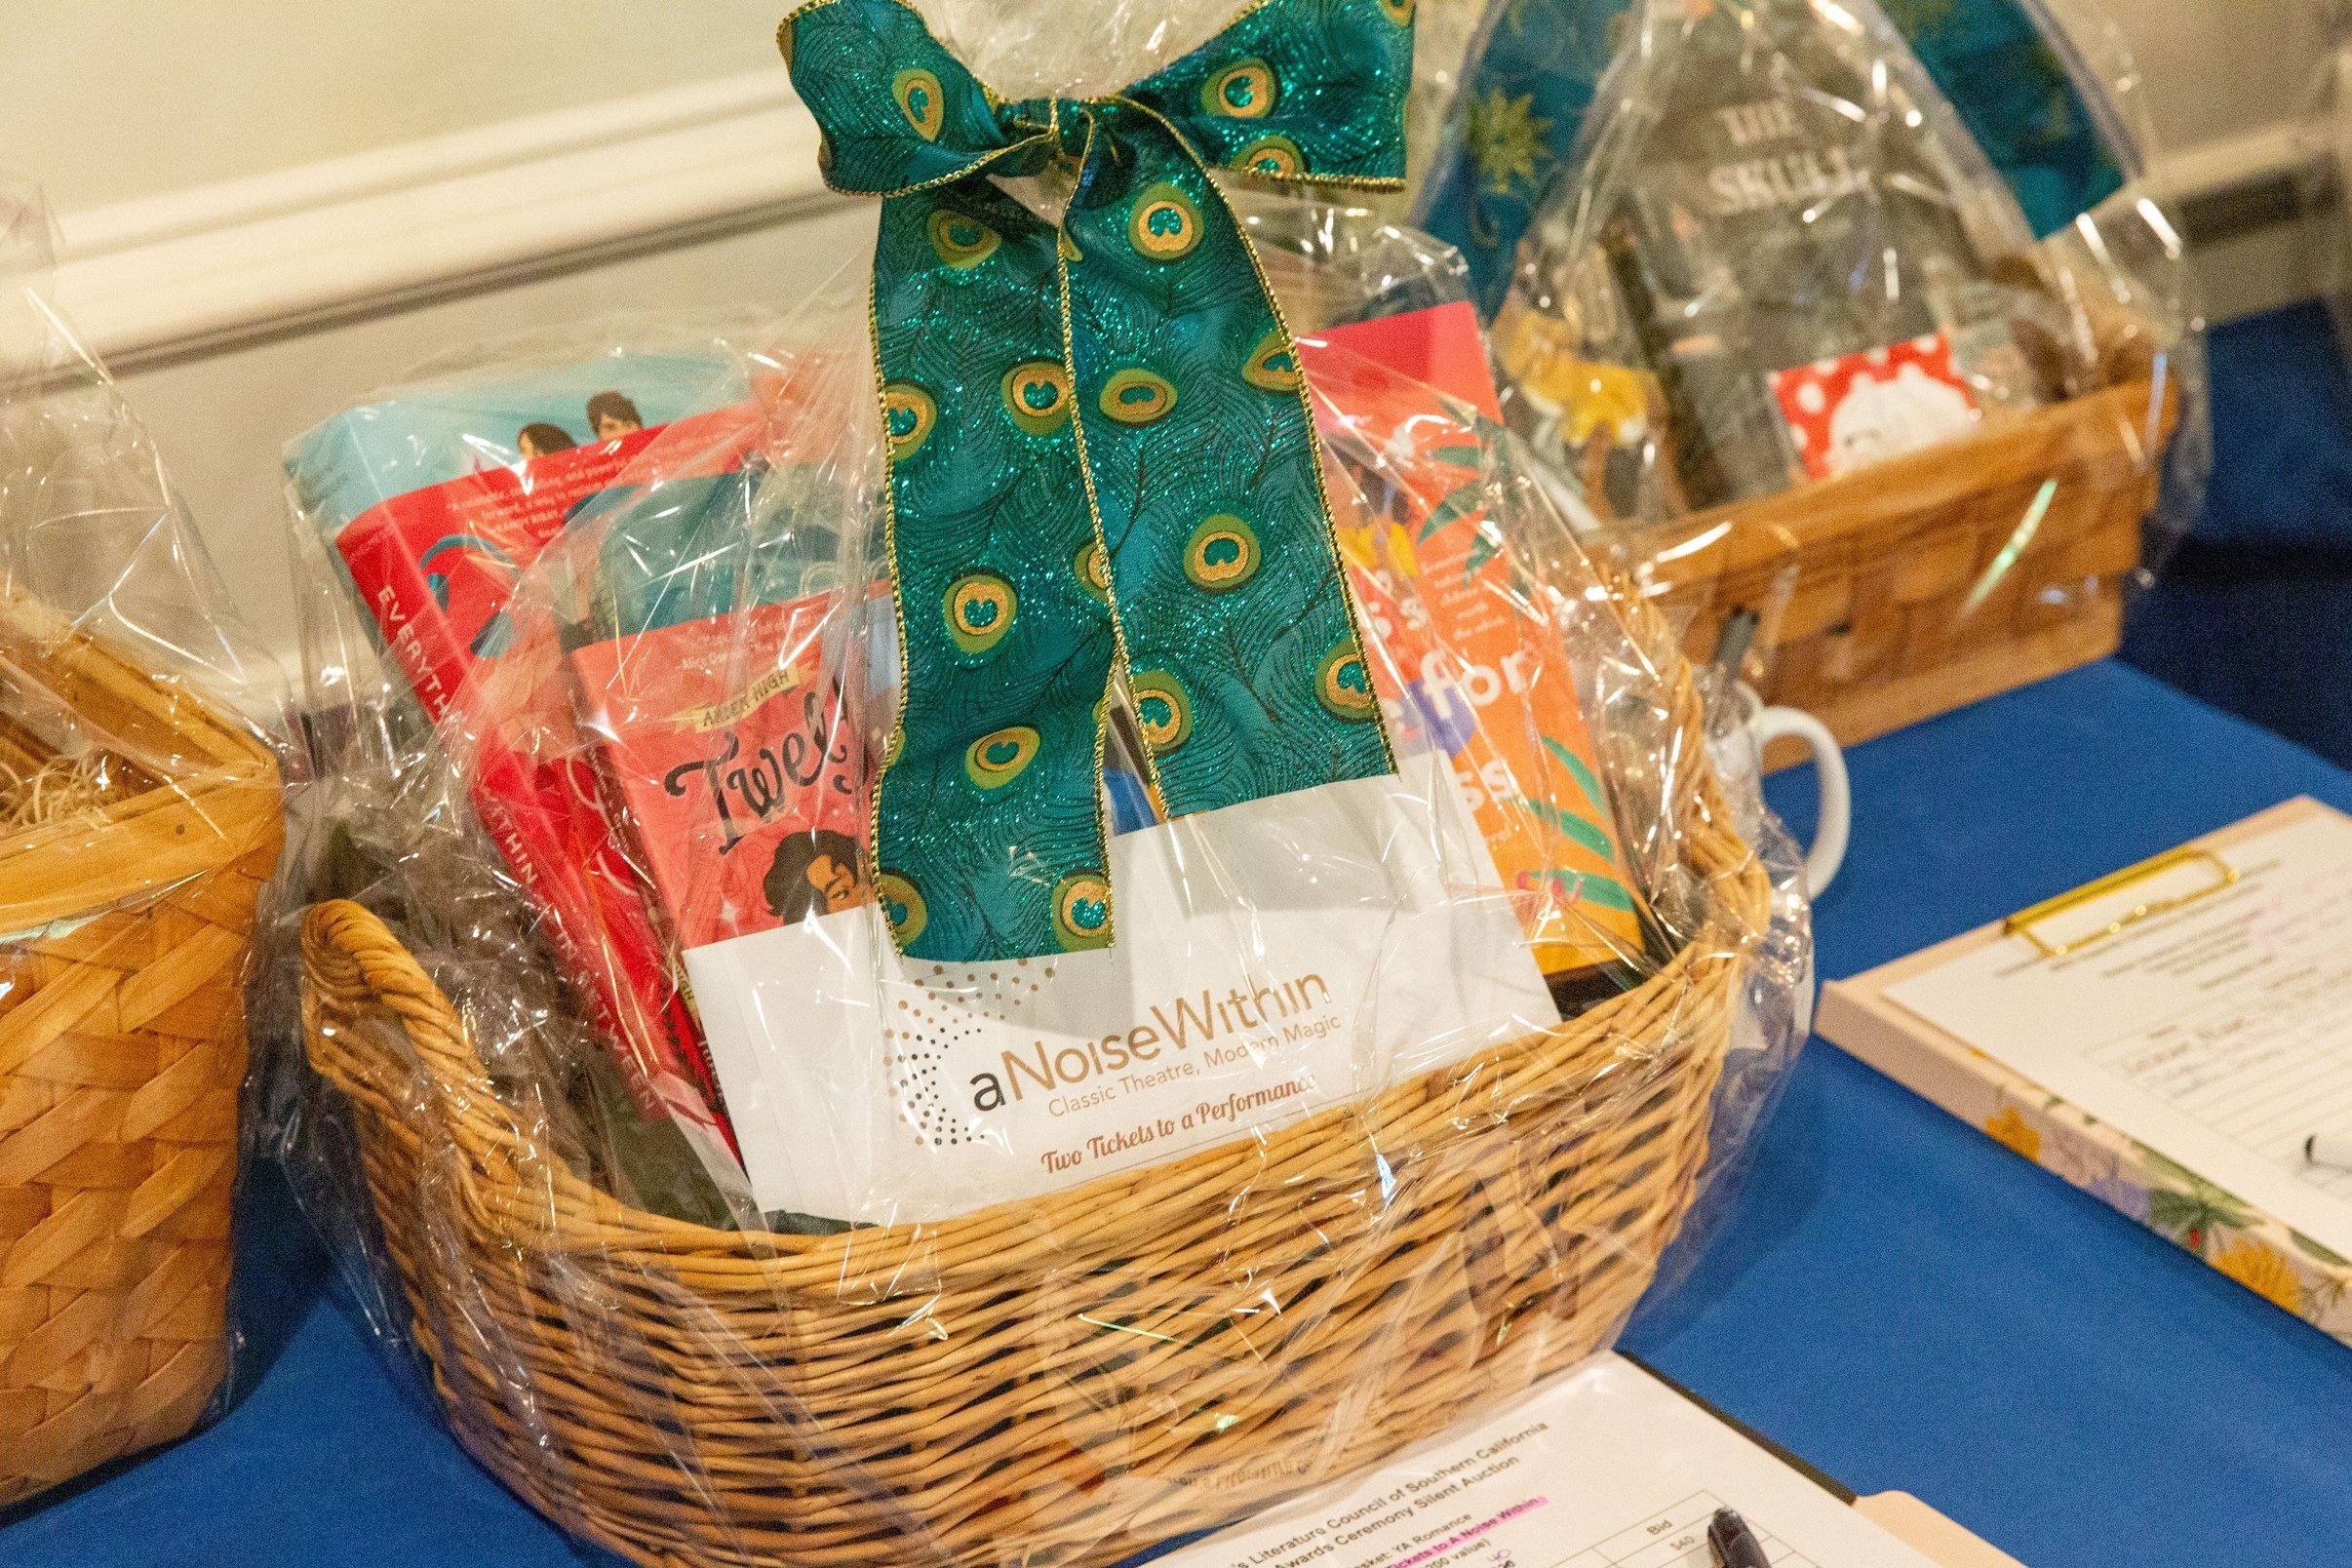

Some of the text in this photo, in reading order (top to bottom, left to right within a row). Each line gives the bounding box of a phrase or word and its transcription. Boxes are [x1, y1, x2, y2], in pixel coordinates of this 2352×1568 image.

[752, 670, 791, 701] HIGH
[1421, 647, 1526, 720] for
[1047, 1085, 1117, 1118] Classic
[1119, 1058, 1201, 1097] Theatre,
[1284, 1015, 1341, 1046] Magic
[1040, 1074, 1316, 1174] Two Tickets to a Performance
[1248, 1422, 1549, 1565] Literature Council of Southern California
[1274, 1455, 1520, 1568] Awards Ceremony Silent Auction
[1432, 1543, 1448, 1552] to
[1448, 1536, 1461, 1545] A
[1461, 1518, 1498, 1537] Noise
[1497, 1498, 1539, 1520] Within
[1392, 1541, 1413, 1553] YA
[1412, 1513, 1472, 1544] Romance
[1452, 1538, 1492, 1560] value)
[1647, 1519, 1673, 1537] Bid
